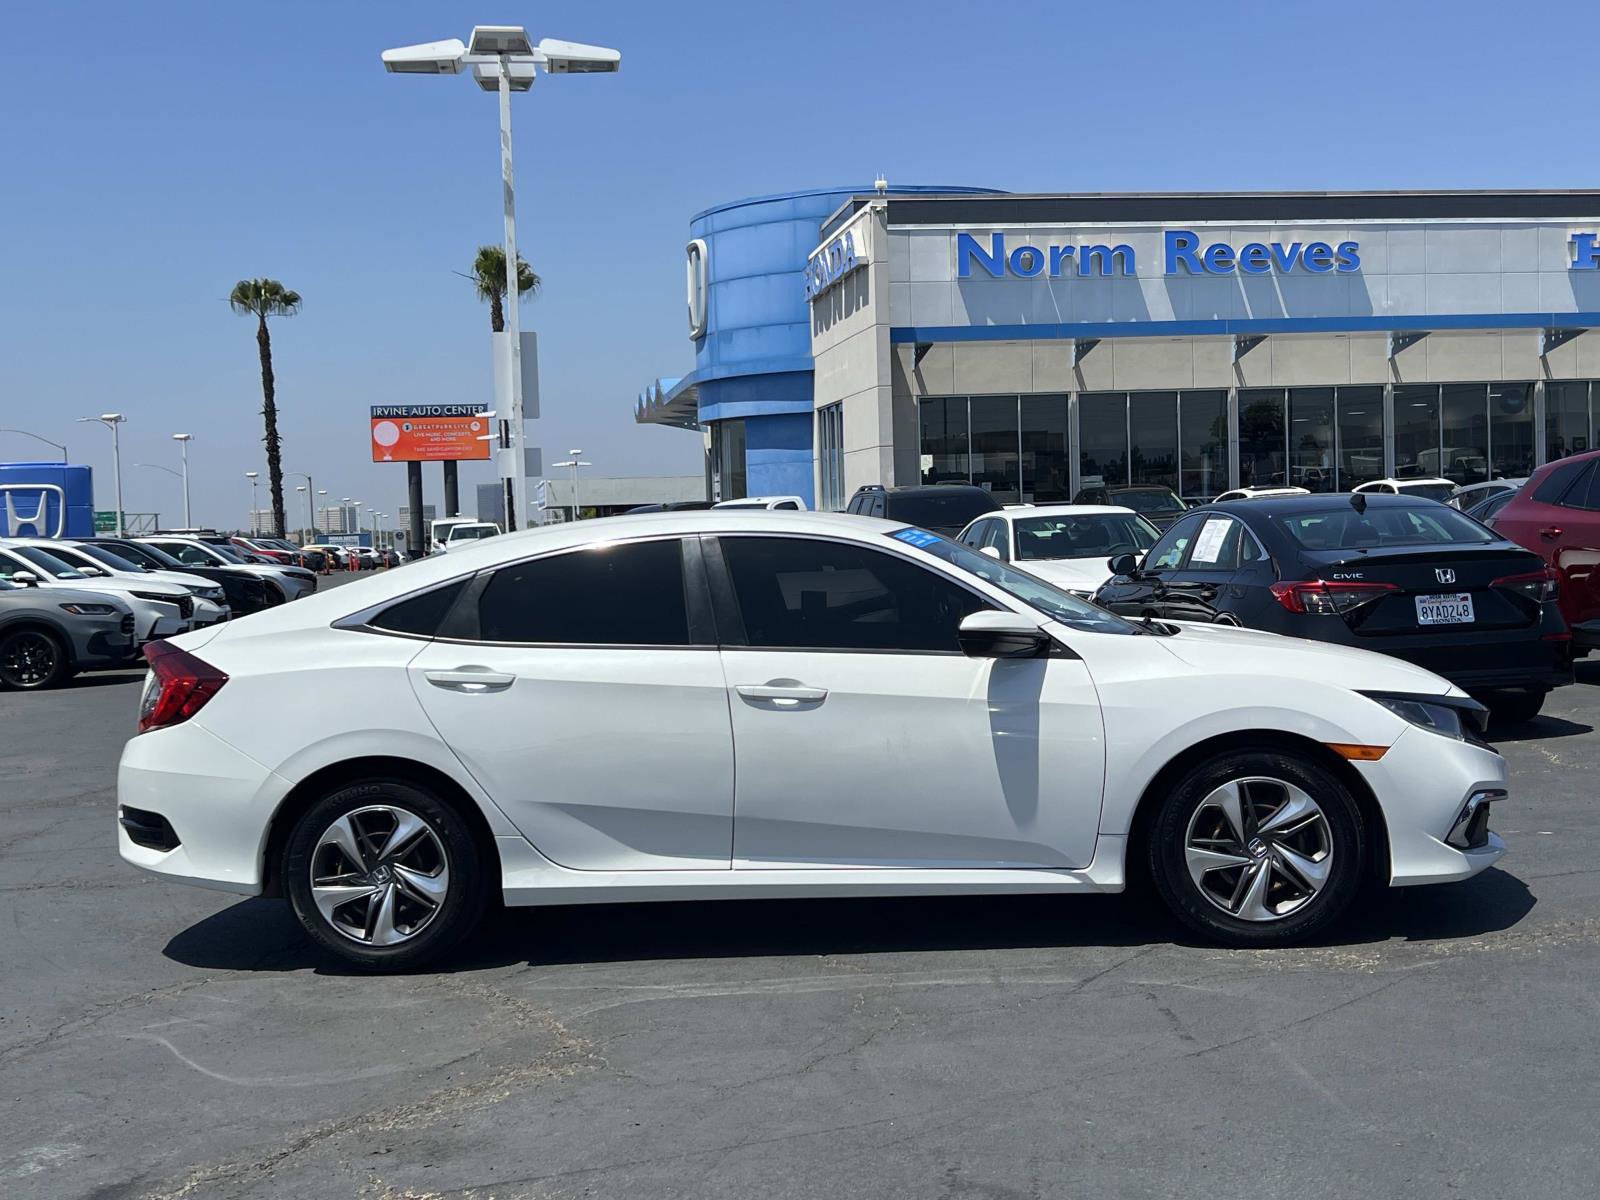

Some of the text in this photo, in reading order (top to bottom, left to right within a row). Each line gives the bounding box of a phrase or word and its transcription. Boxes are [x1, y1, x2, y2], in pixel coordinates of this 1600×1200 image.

[957, 232, 1136, 278] Norm
[1163, 230, 1361, 275] Reeves
[373, 405, 484, 416] IRVINE AUTO CENTER
[1421, 604, 1470, 620] 8YAD248
